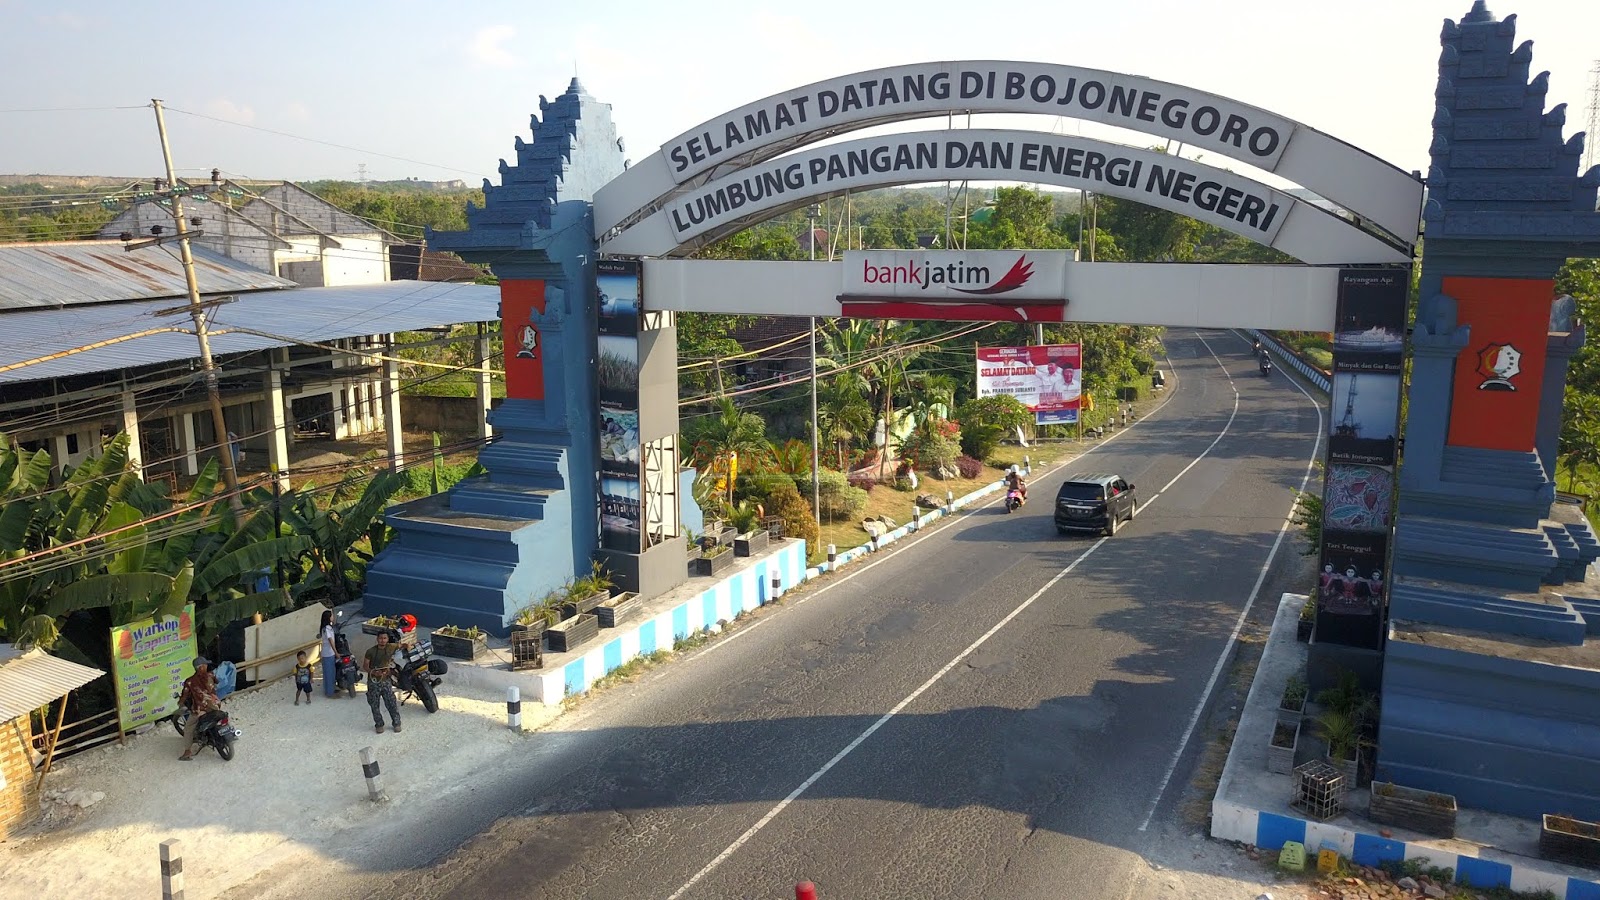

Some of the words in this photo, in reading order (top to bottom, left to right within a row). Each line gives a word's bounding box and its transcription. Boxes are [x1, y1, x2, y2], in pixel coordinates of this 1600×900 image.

[670, 95, 809, 172] SELAMAT
[817, 72, 950, 118] DATANG
[960, 71, 996, 99] DI
[1004, 72, 1280, 157] BOJONEGORO
[672, 163, 805, 233] LUMBUNG
[808, 142, 938, 185] PANGAN
[945, 141, 1013, 170] DAN
[1019, 143, 1143, 188] ENERGI
[1145, 164, 1280, 232] NEGERI
[863, 259, 990, 290] bankjatim
[1344, 276, 1379, 285] Kayangan
[1380, 277, 1393, 285] Api
[981, 367, 1010, 377] SELAMAT
[1011, 366, 1037, 376] DATANG
[1351, 453, 1383, 462] Jonegoro
[133, 620, 179, 641] Warkop
[134, 632, 179, 655] Gapura
[127, 681, 141, 690] Soto
[141, 675, 159, 685] Ayam
